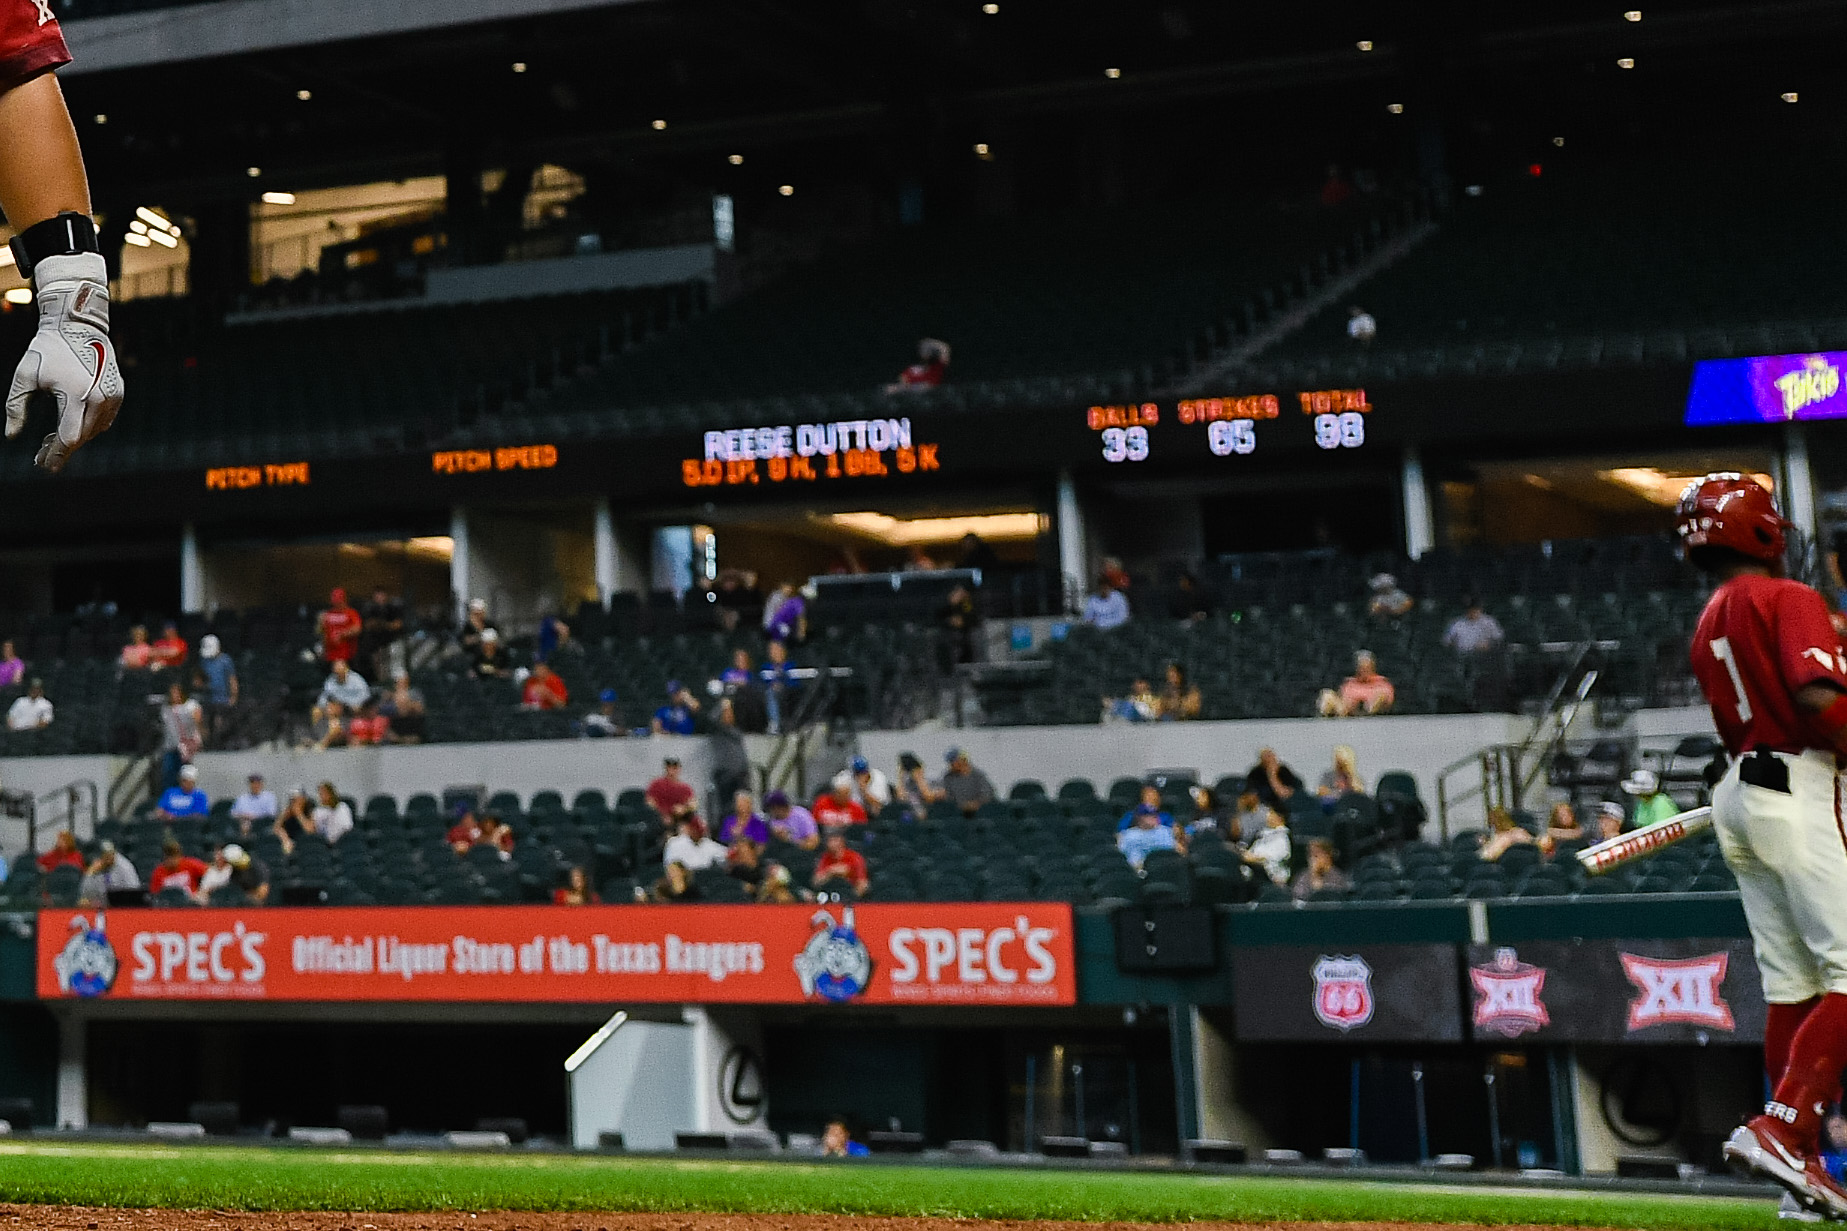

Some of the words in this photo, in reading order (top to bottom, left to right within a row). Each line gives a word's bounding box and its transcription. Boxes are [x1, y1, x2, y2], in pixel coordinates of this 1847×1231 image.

[704, 425, 793, 462] REESE
[796, 417, 911, 457] DUTTON
[1709, 636, 1753, 724] 1
[131, 920, 268, 982] SPEC'S
[291, 935, 374, 974] Official
[377, 936, 449, 981] Liquor
[451, 934, 516, 974] Store
[519, 935, 544, 973] of
[548, 935, 589, 973] the
[591, 933, 661, 973] Texas
[664, 933, 765, 982] Rangers
[889, 914, 1058, 984] SPEC'S
[1630, 961, 1726, 1020] XII
